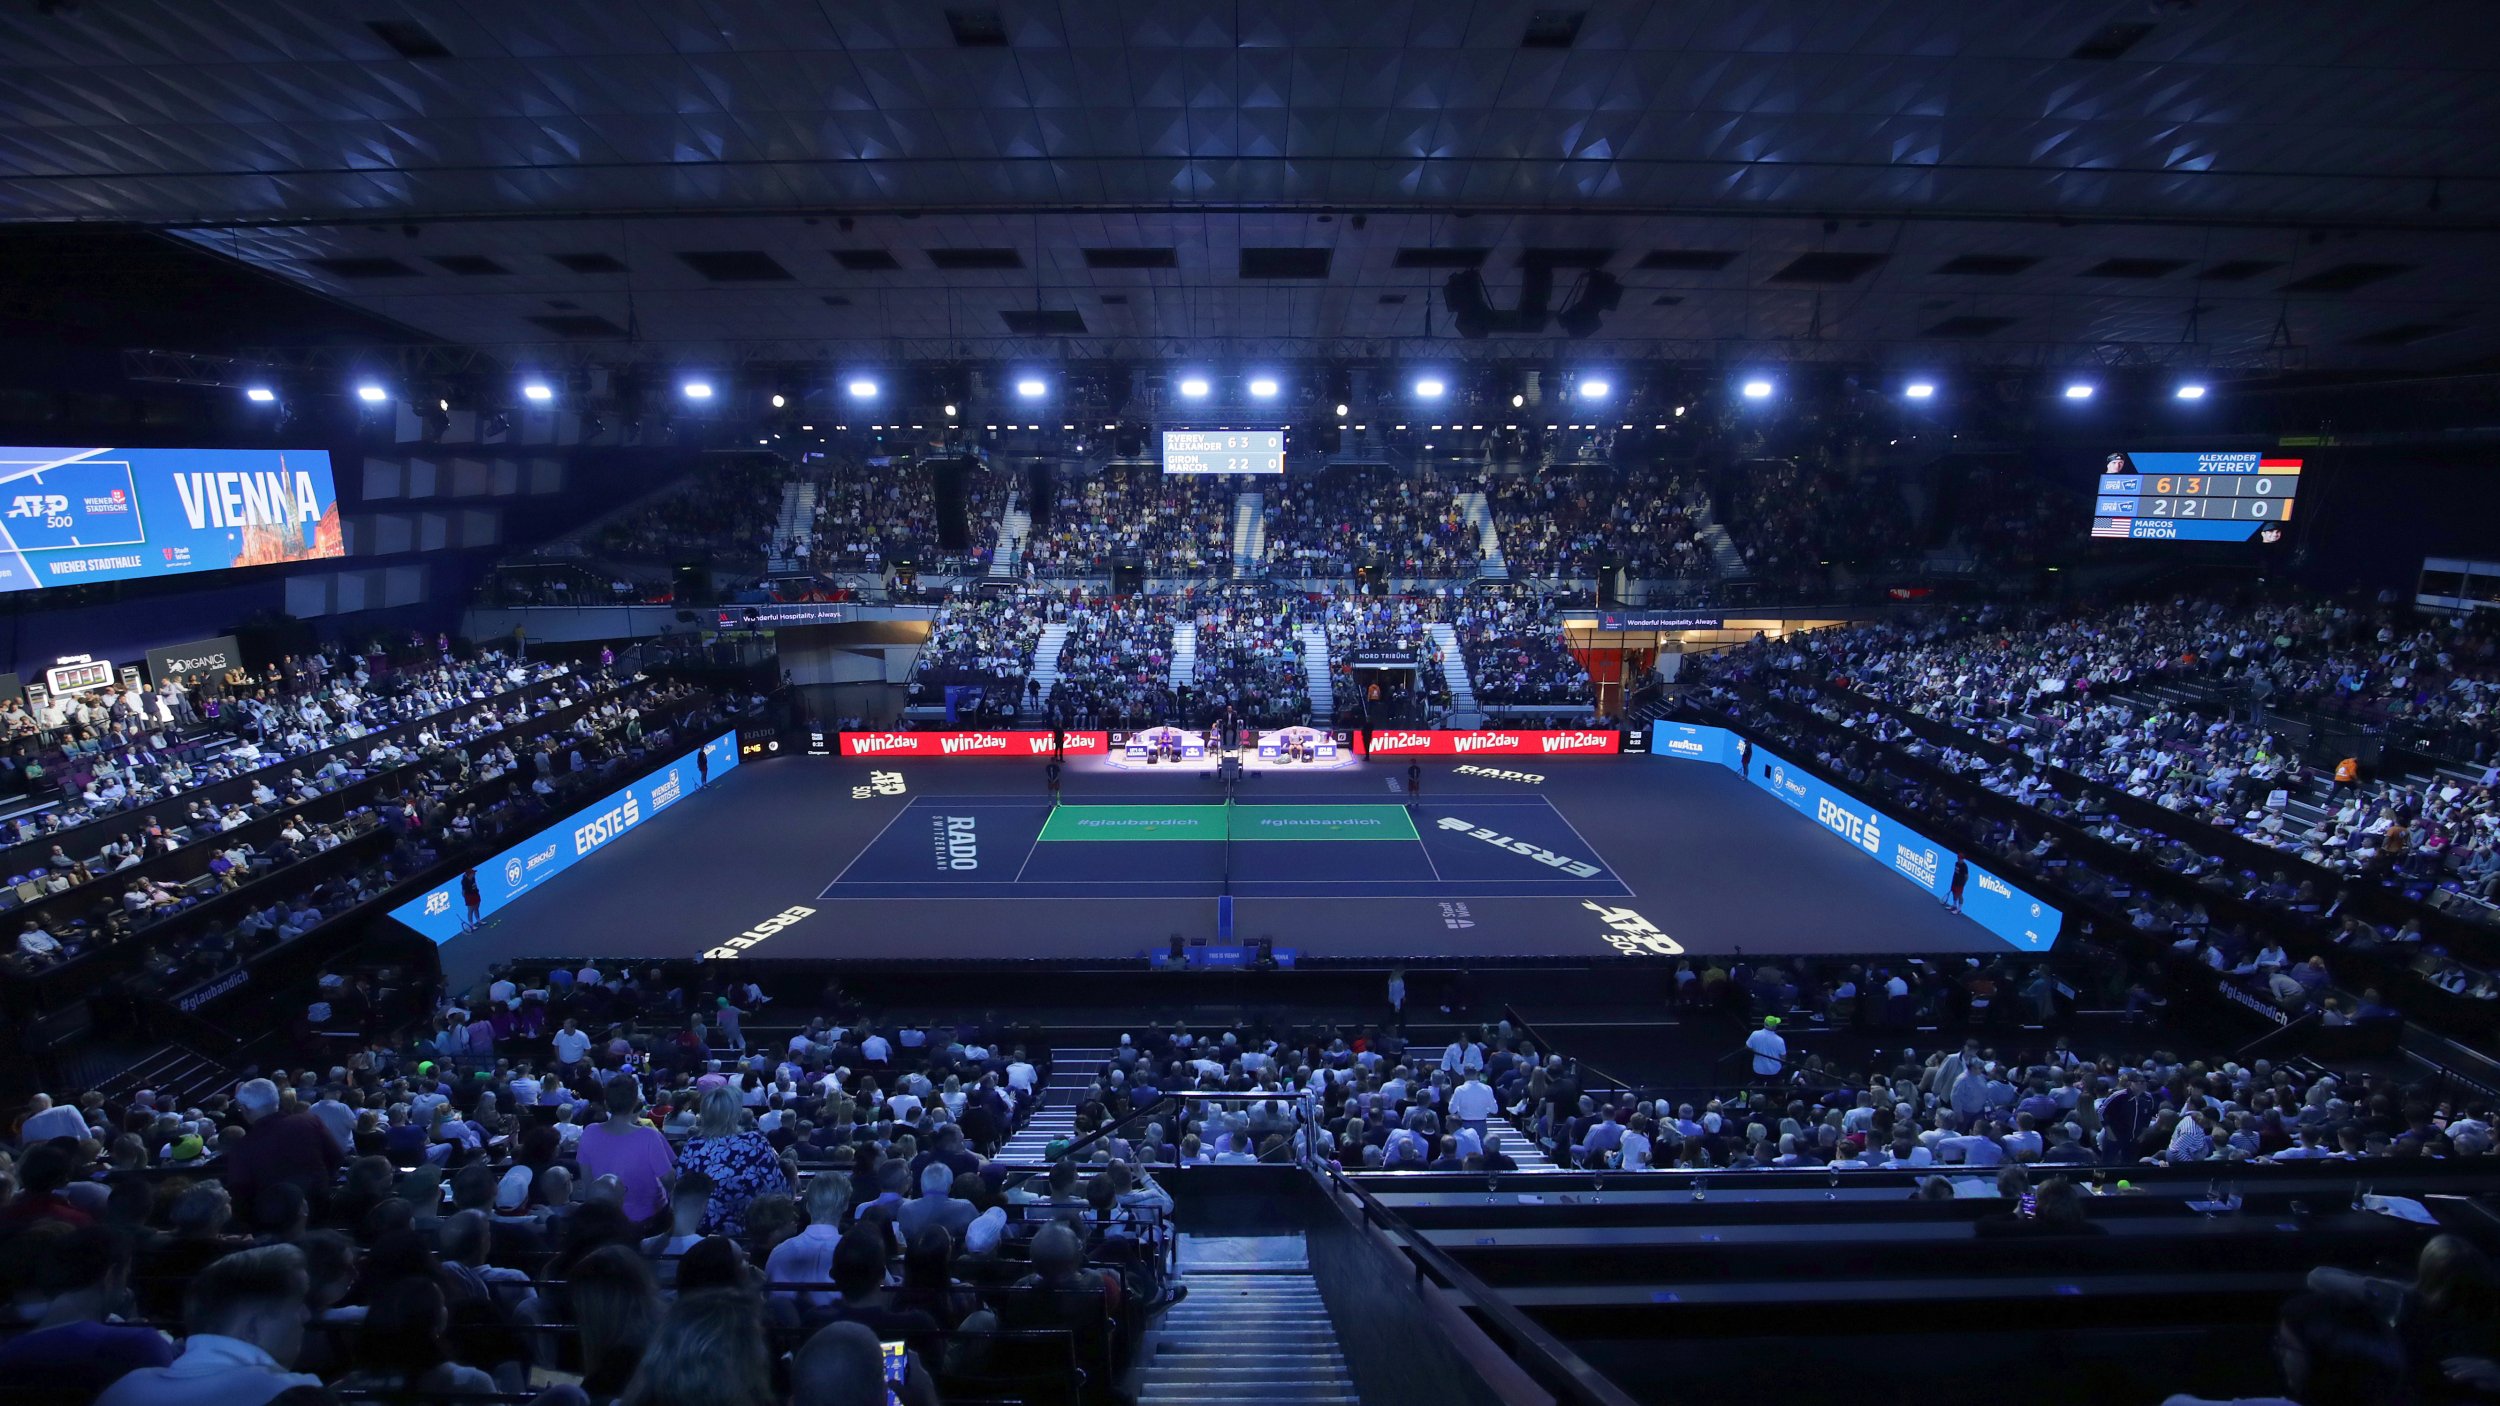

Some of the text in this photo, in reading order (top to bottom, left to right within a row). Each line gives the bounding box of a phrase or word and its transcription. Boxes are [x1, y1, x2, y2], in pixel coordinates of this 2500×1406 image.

[1167, 434, 1205, 442] ZVEREV
[1228, 437, 1277, 448] 6 3 0
[1168, 442, 1222, 451] ALEXANDER
[1228, 459, 1277, 469] 2 2 0
[2198, 454, 2256, 462] ALEXANDER
[1168, 463, 1208, 471] MARCOS
[2198, 462, 2255, 472] ZVEREV
[2156, 478, 2272, 494] 6 3 0
[4, 494, 68, 518] ATP
[84, 497, 114, 506] WIENER
[86, 502, 128, 513] STÄDTISCHE
[173, 471, 321, 529] VIENNA
[2152, 500, 2268, 517] 2 2 0
[47, 516, 72, 528] 500
[2135, 520, 2173, 528] MARCOS
[2133, 528, 2176, 538] GIRON
[50, 555, 142, 574] WIENER STADTHALLE
[1660, 619, 1694, 627] Hospitality.
[176, 653, 226, 672] ORGANICS
[744, 728, 775, 740] RADO
[743, 743, 761, 754] 0:46
[1457, 764, 1546, 782] RADO
[651, 780, 671, 798] WIENER
[870, 770, 907, 795] ATP
[652, 785, 681, 808] STÄDTISCHE
[852, 786, 871, 800] 500
[1078, 817, 1381, 828] #glaubandich #glaubandich
[1818, 797, 1863, 844] ERSTE
[575, 806, 624, 855] ERSTE
[932, 815, 948, 871] SWITZERLAND
[947, 816, 978, 870] RADO
[1468, 828, 1602, 878] ERSTE
[1897, 844, 1924, 866] WIENER
[508, 867, 520, 881] 99
[1896, 853, 1935, 885] STÄDTISCHE
[1438, 902, 1456, 918] Stadt
[1455, 902, 1471, 918] Wien
[724, 905, 816, 949] ERSTE
[1581, 899, 1685, 955] ATP
[180, 969, 249, 1013] #glaubandich
[2218, 979, 2288, 1026] #glaubandich
